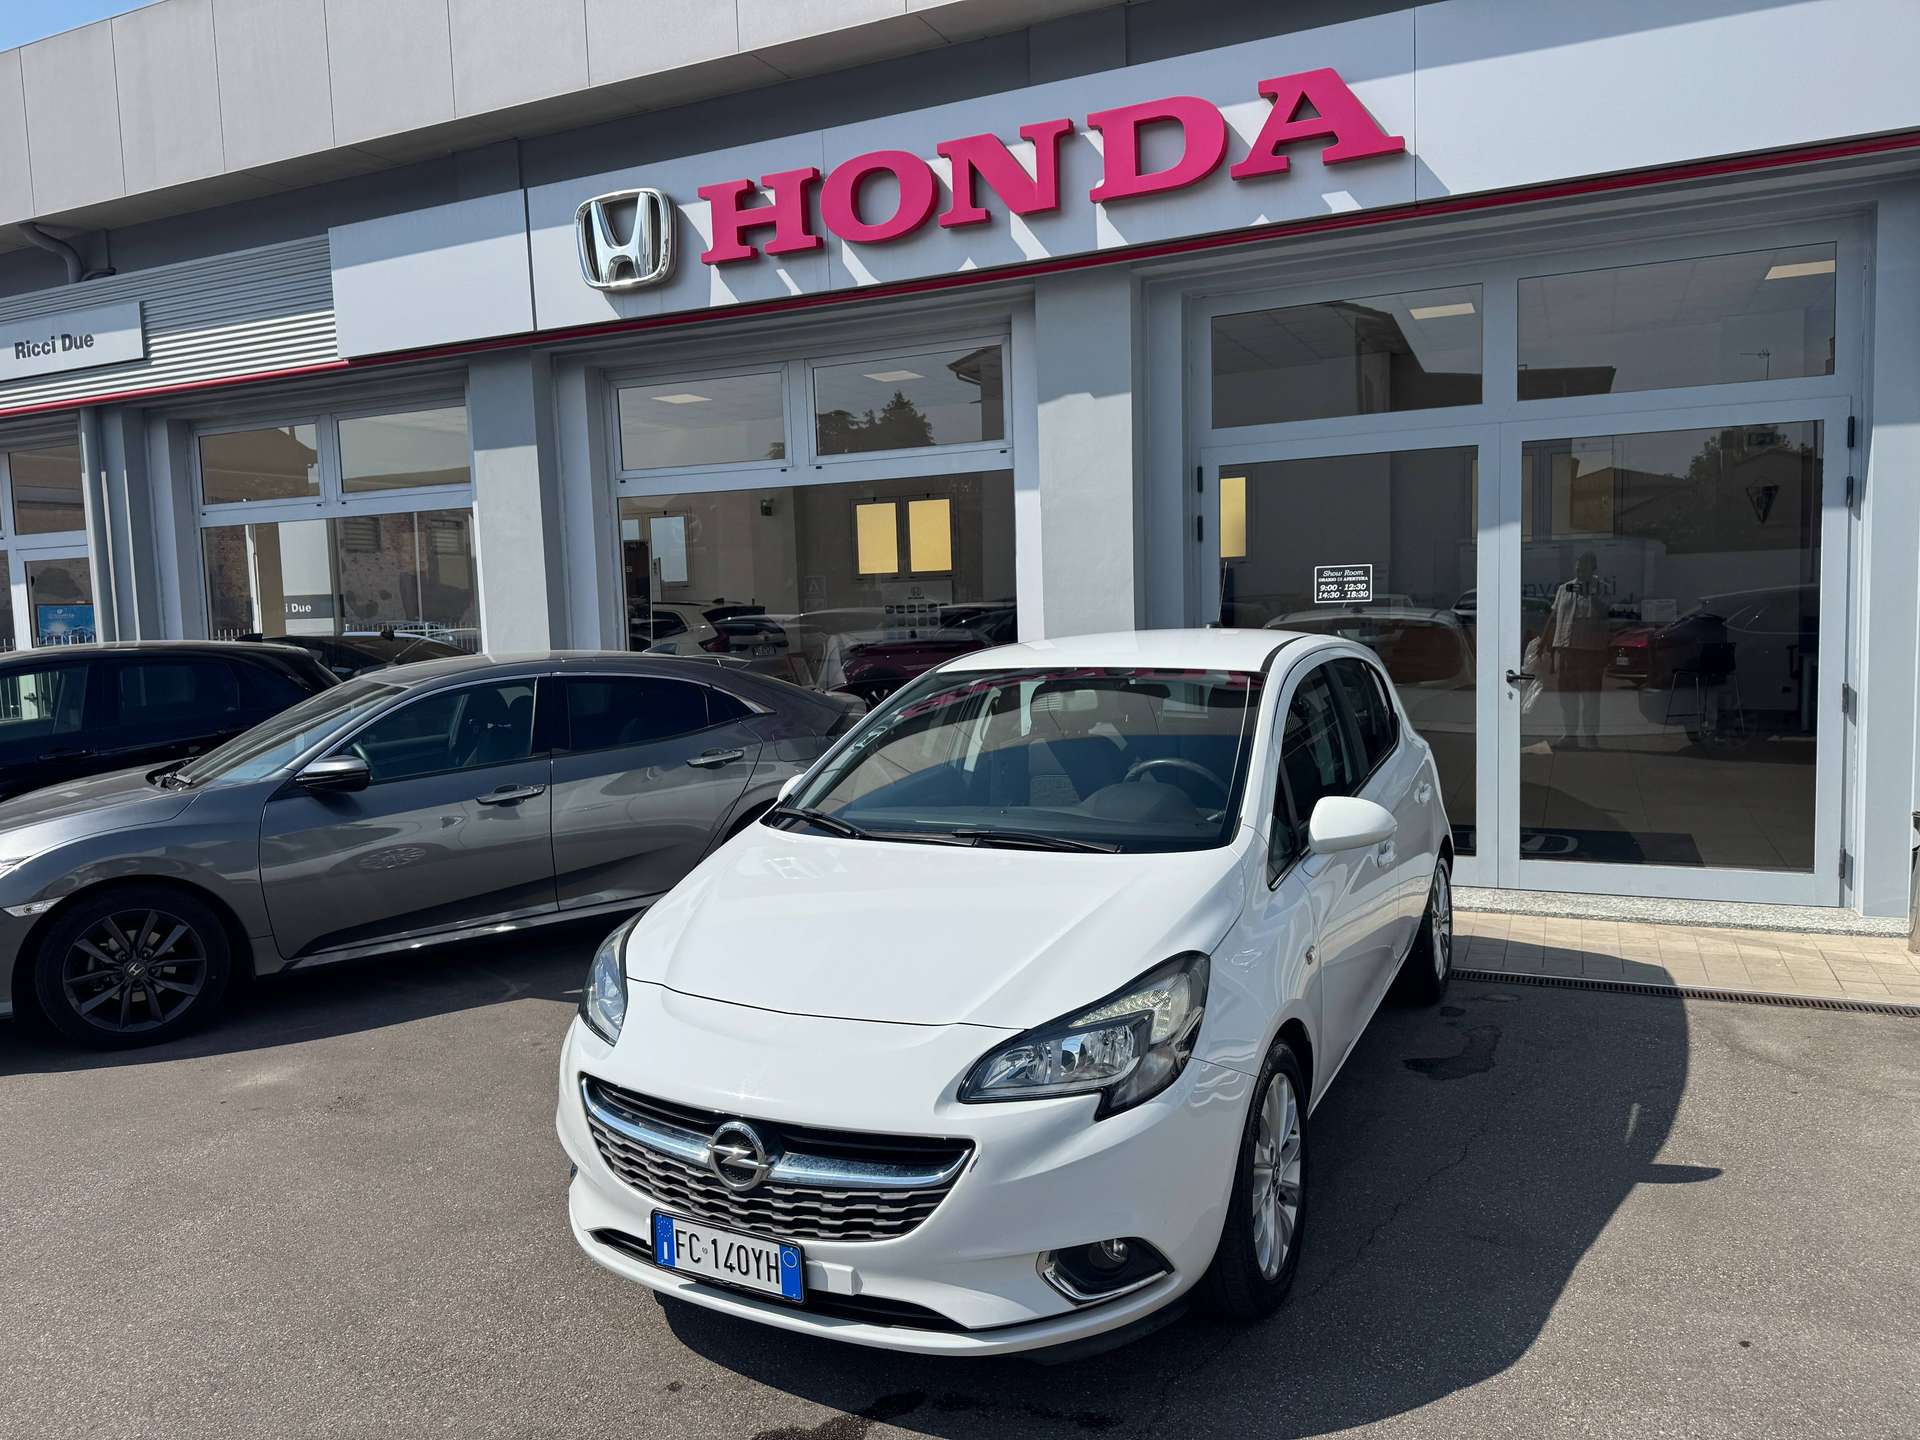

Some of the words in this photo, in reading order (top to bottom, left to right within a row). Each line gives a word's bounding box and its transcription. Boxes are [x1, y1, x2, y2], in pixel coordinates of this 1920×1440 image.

[698, 68, 1405, 265] HONDA
[14, 336, 57, 360] Ricci
[60, 333, 95, 352] Due
[1344, 569, 1364, 577] Room
[1320, 584, 1338, 592] 9:00
[1344, 583, 1367, 591] 12:30
[1318, 591, 1340, 599] 14:30
[1346, 590, 1369, 598] 18:30
[291, 603, 312, 613] Due
